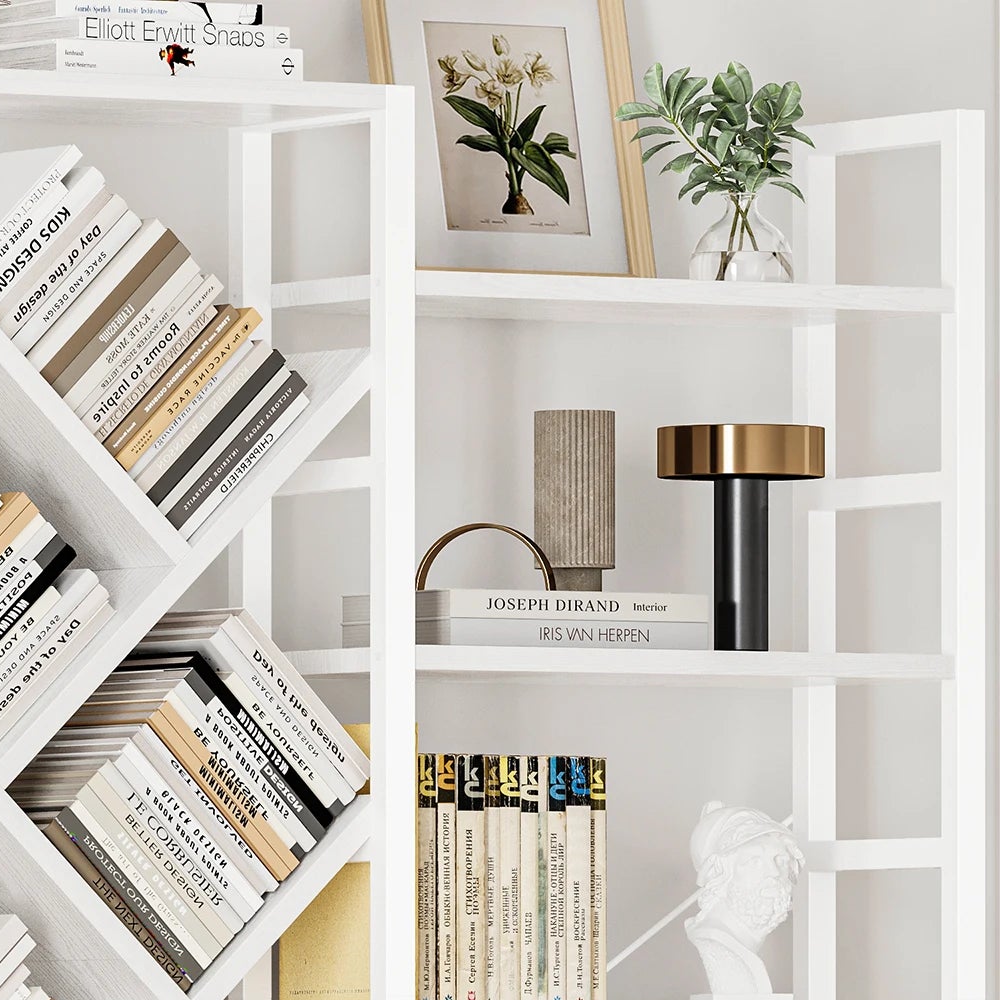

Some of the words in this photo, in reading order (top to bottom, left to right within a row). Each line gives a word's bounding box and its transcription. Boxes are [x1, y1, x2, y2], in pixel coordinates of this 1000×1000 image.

[85, 17, 135, 41] Elliott
[143, 20, 196, 44] Erwitt
[202, 22, 265, 48] Snaps
[9, 218, 33, 245] COFFEE
[40, 206, 71, 242] KIDS
[80, 225, 101, 250] Day
[68, 249, 79, 267] of
[84, 251, 107, 276] SPACE
[48, 263, 67, 283] the
[69, 276, 83, 293] AND
[14, 283, 48, 322] design
[43, 293, 69, 322] DESIGN
[486, 598, 549, 611] JOSEPH
[556, 599, 620, 613] DIRAND
[633, 602, 668, 613] Interior
[539, 627, 563, 641] IRIS
[566, 627, 593, 642] VAN
[598, 628, 650, 643] HERPEN
[465, 829, 475, 915] СТИХОТВОРЕНИЯ
[443, 856, 451, 927] ОБЫКНОВЕННАЯ
[573, 881, 582, 941] ВОСКРЕСЕНИЕ
[468, 954, 477, 983] Сергей
